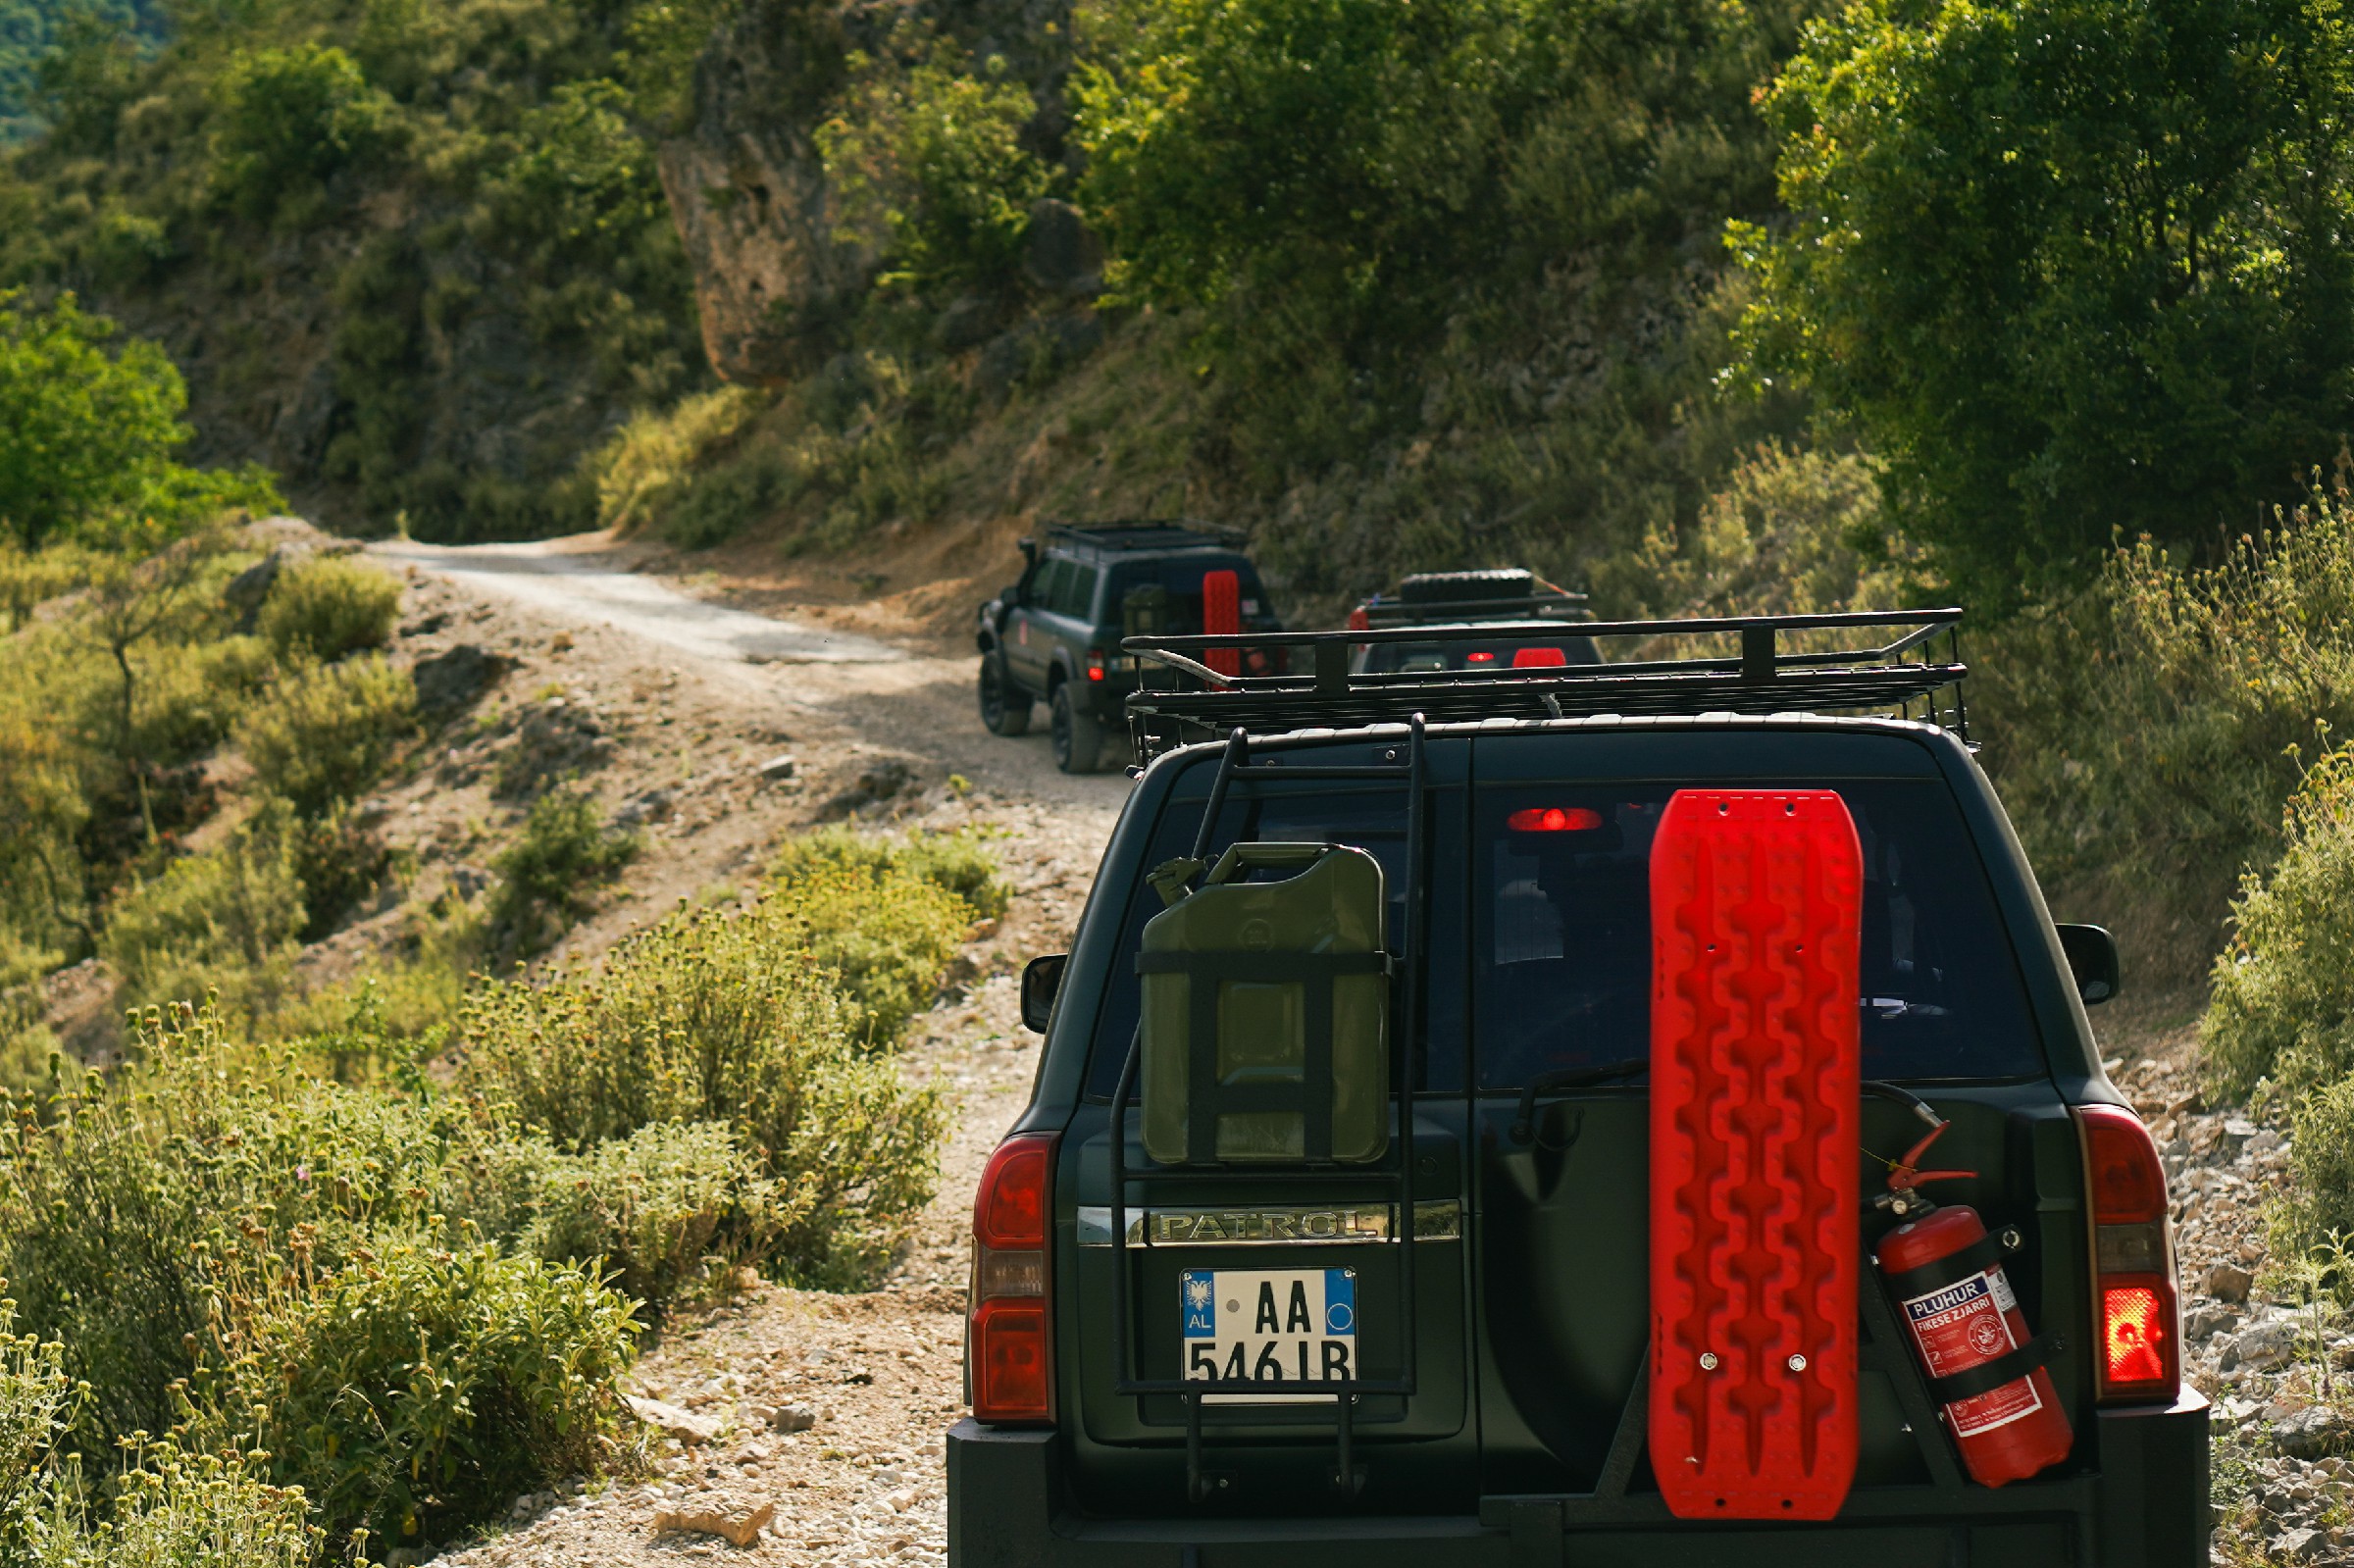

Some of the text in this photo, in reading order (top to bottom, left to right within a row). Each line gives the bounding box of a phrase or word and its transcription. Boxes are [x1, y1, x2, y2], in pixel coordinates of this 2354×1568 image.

[1160, 1210, 1377, 1240] PATROL
[1254, 1281, 1311, 1334] AA
[1914, 1283, 1979, 1317] PLUHUR
[1917, 1313, 1952, 1332] FIKESE
[1952, 1297, 1990, 1321] ZJARRI
[1189, 1314, 1212, 1329] AL
